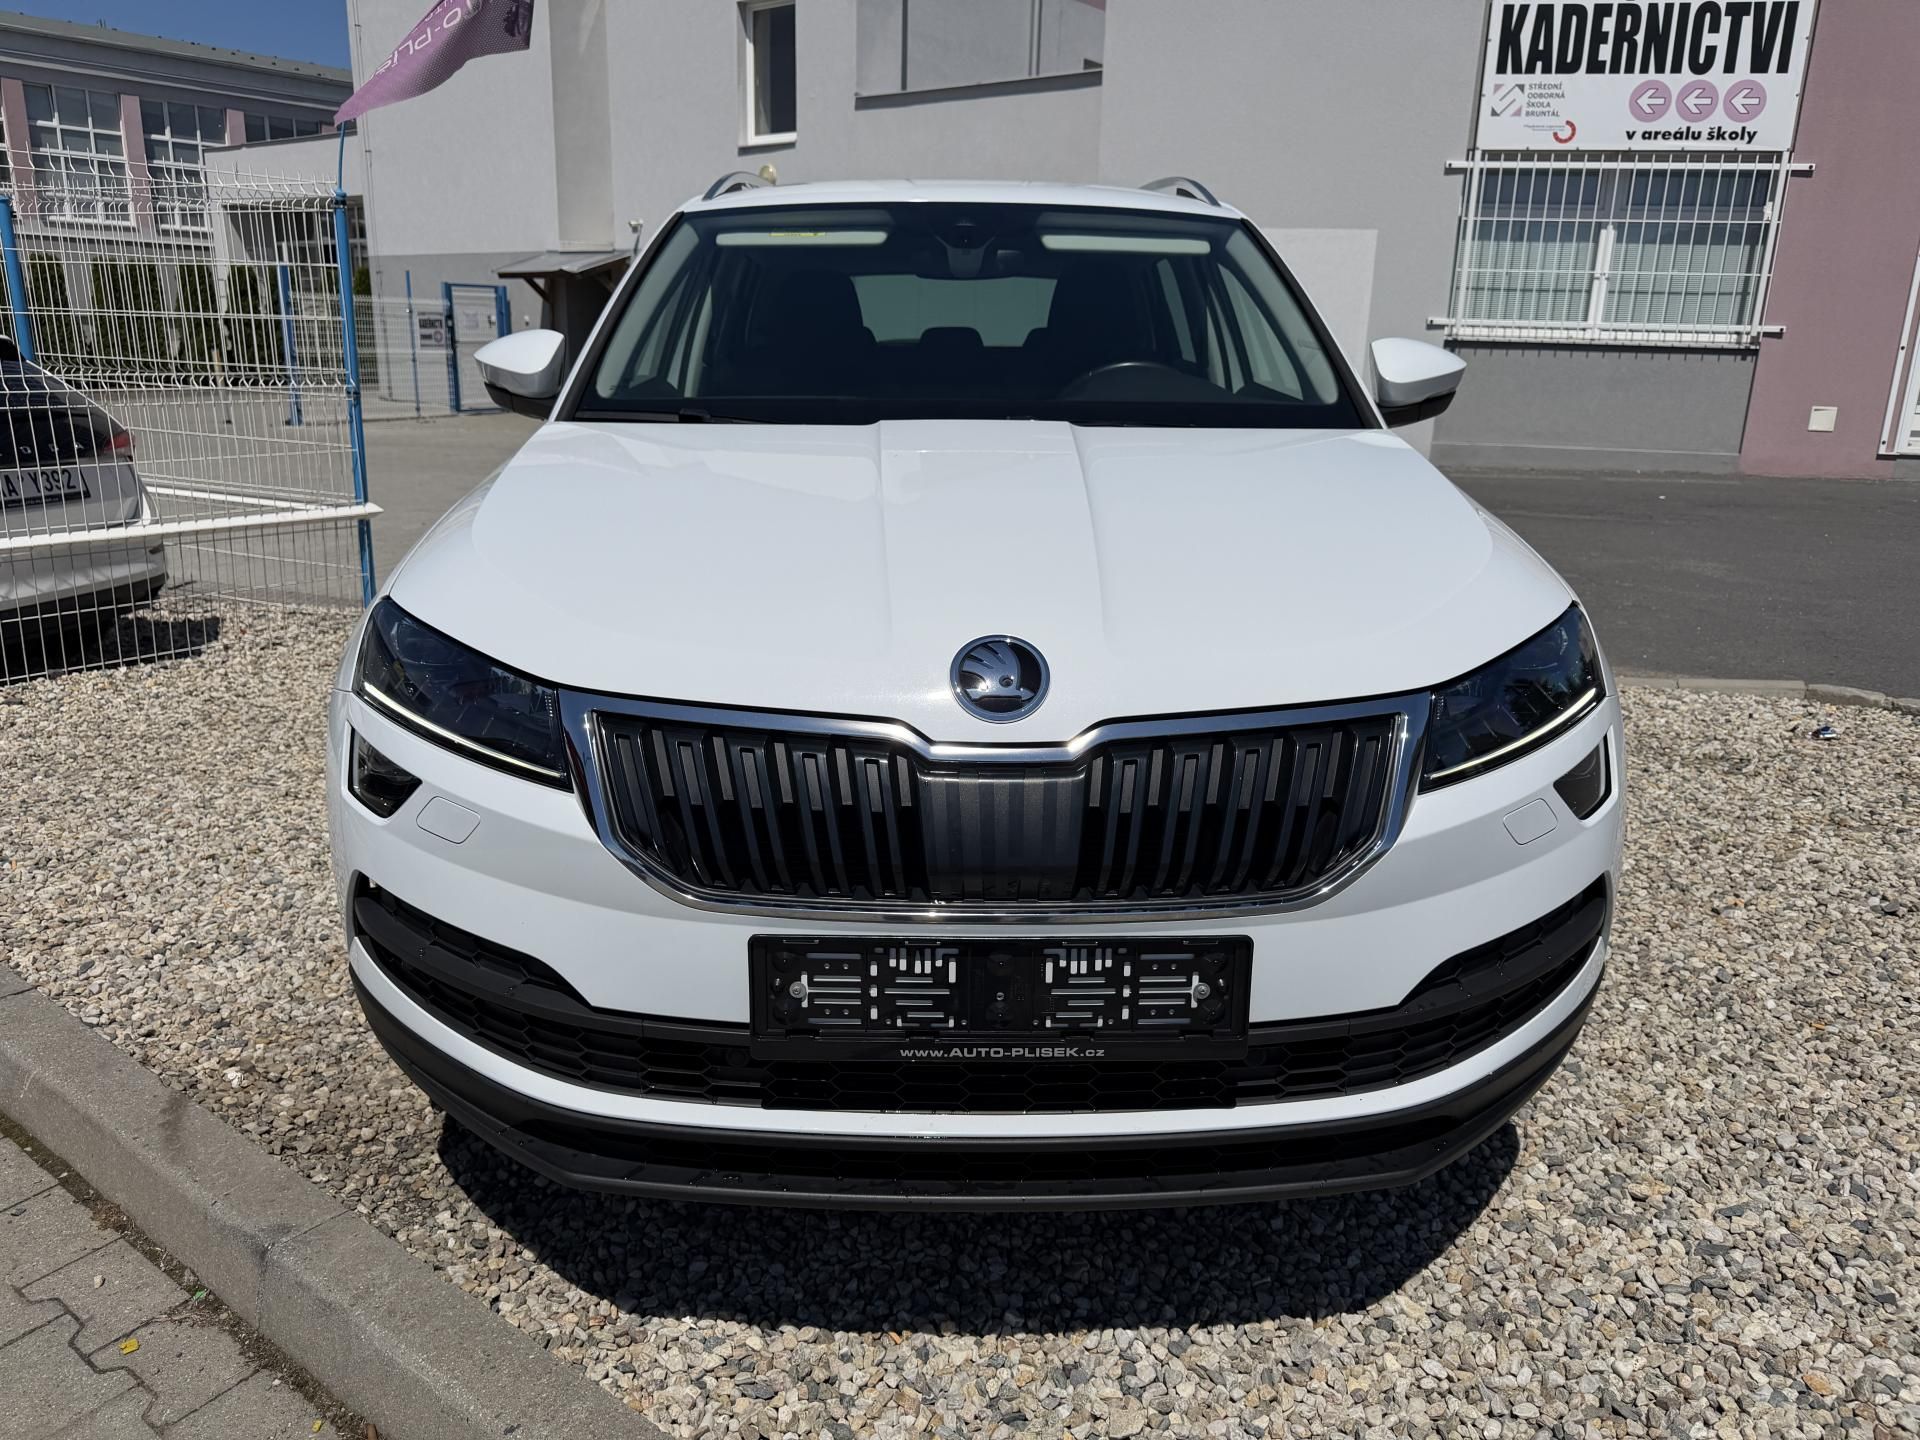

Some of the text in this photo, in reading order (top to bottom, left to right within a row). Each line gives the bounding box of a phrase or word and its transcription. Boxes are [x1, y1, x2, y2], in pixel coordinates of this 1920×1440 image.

[1528, 81, 1563, 90] STŘEDNÍ
[1527, 91, 1566, 99] ODBORNÁ
[1526, 100, 1551, 108] ŠKOLA
[1525, 109, 1560, 117] BRUNTÁL
[1625, 126, 1758, 144] v areálu školy
[900, 1047, 1105, 1058] www.AUTO-PLISEK.cz
